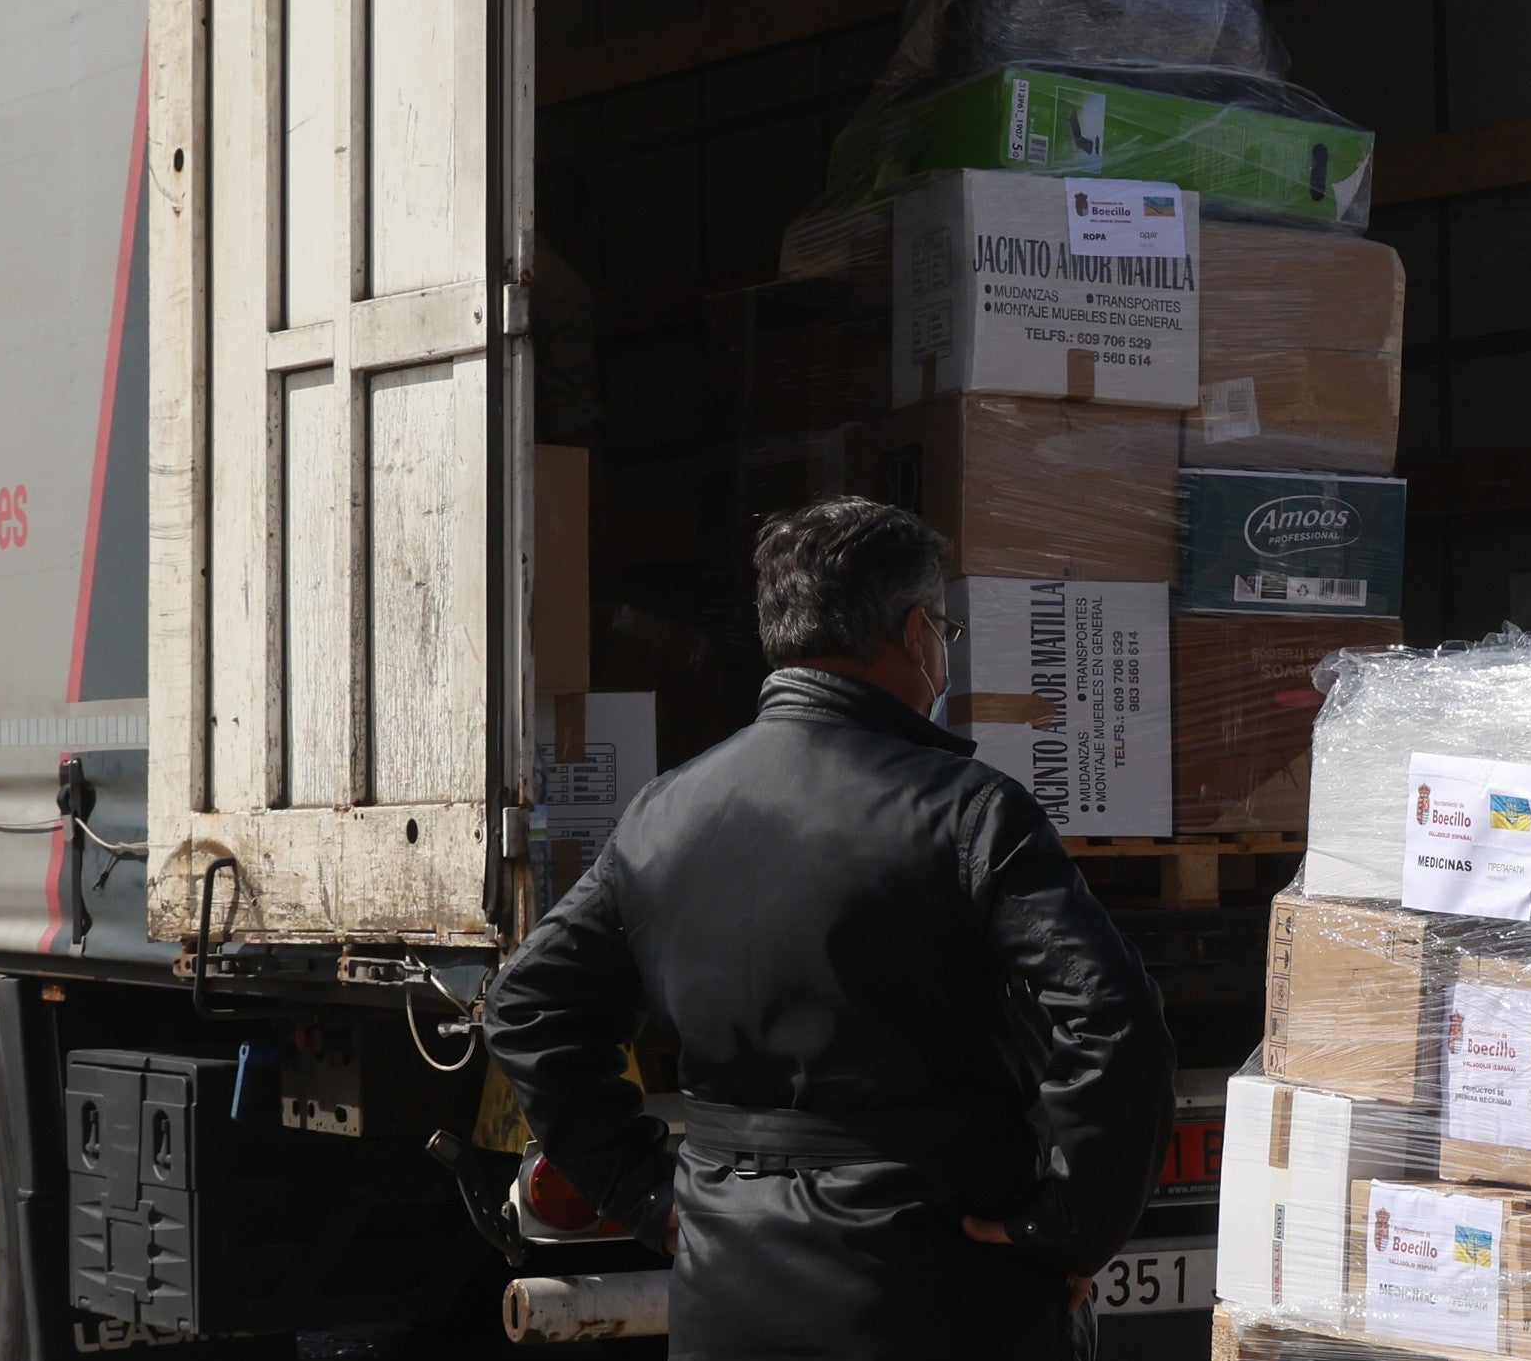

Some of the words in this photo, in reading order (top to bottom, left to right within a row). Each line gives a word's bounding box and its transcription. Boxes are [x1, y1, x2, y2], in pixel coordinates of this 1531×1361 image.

[1091, 206, 1131, 217] Boecillo
[1083, 232, 1107, 241] ROPA
[973, 235, 1051, 279] JACINTO
[1056, 241, 1112, 284] AMOR
[994, 285, 1059, 302] MUDANZAS
[1096, 294, 1181, 313] TRANSPORTES
[994, 302, 1048, 319] MONTAJE
[1052, 307, 1106, 323] MUEBLES
[1110, 312, 1125, 325] EN
[1128, 315, 1183, 330] GENERAL
[1025, 327, 1073, 342] TELFS.:
[1077, 333, 1097, 345] 609
[1103, 335, 1125, 347] 706
[1129, 337, 1152, 349] 529
[1103, 352, 1125, 365] 560
[1129, 354, 1152, 367] 614
[1255, 509, 1350, 534] Amoos
[1269, 531, 1340, 545] PROFESSIONAL
[1030, 582, 1066, 667] MATILLA
[1092, 596, 1103, 655] GENERAL
[1076, 597, 1087, 691] TRANSPORTES
[1112, 630, 1123, 655] 529
[1128, 630, 1139, 655] 614
[1092, 659, 1103, 676] EN
[1113, 660, 1124, 684] 706
[1128, 660, 1139, 683] 560
[1093, 679, 1105, 739] MUEBLES
[1113, 689, 1125, 712] 609
[1129, 689, 1140, 712] 983
[1114, 716, 1125, 768] TELFS.:
[1079, 731, 1092, 802] MUDANZAS
[1094, 743, 1107, 802] MONTAJE
[1432, 810, 1471, 827] Boecillo
[1418, 855, 1472, 872] MEDICINAS
[1488, 862, 1525, 874] ПРЕПАРАТИ
[1468, 1039, 1516, 1058] Boecillo
[1392, 1237, 1438, 1258] Boecillo
